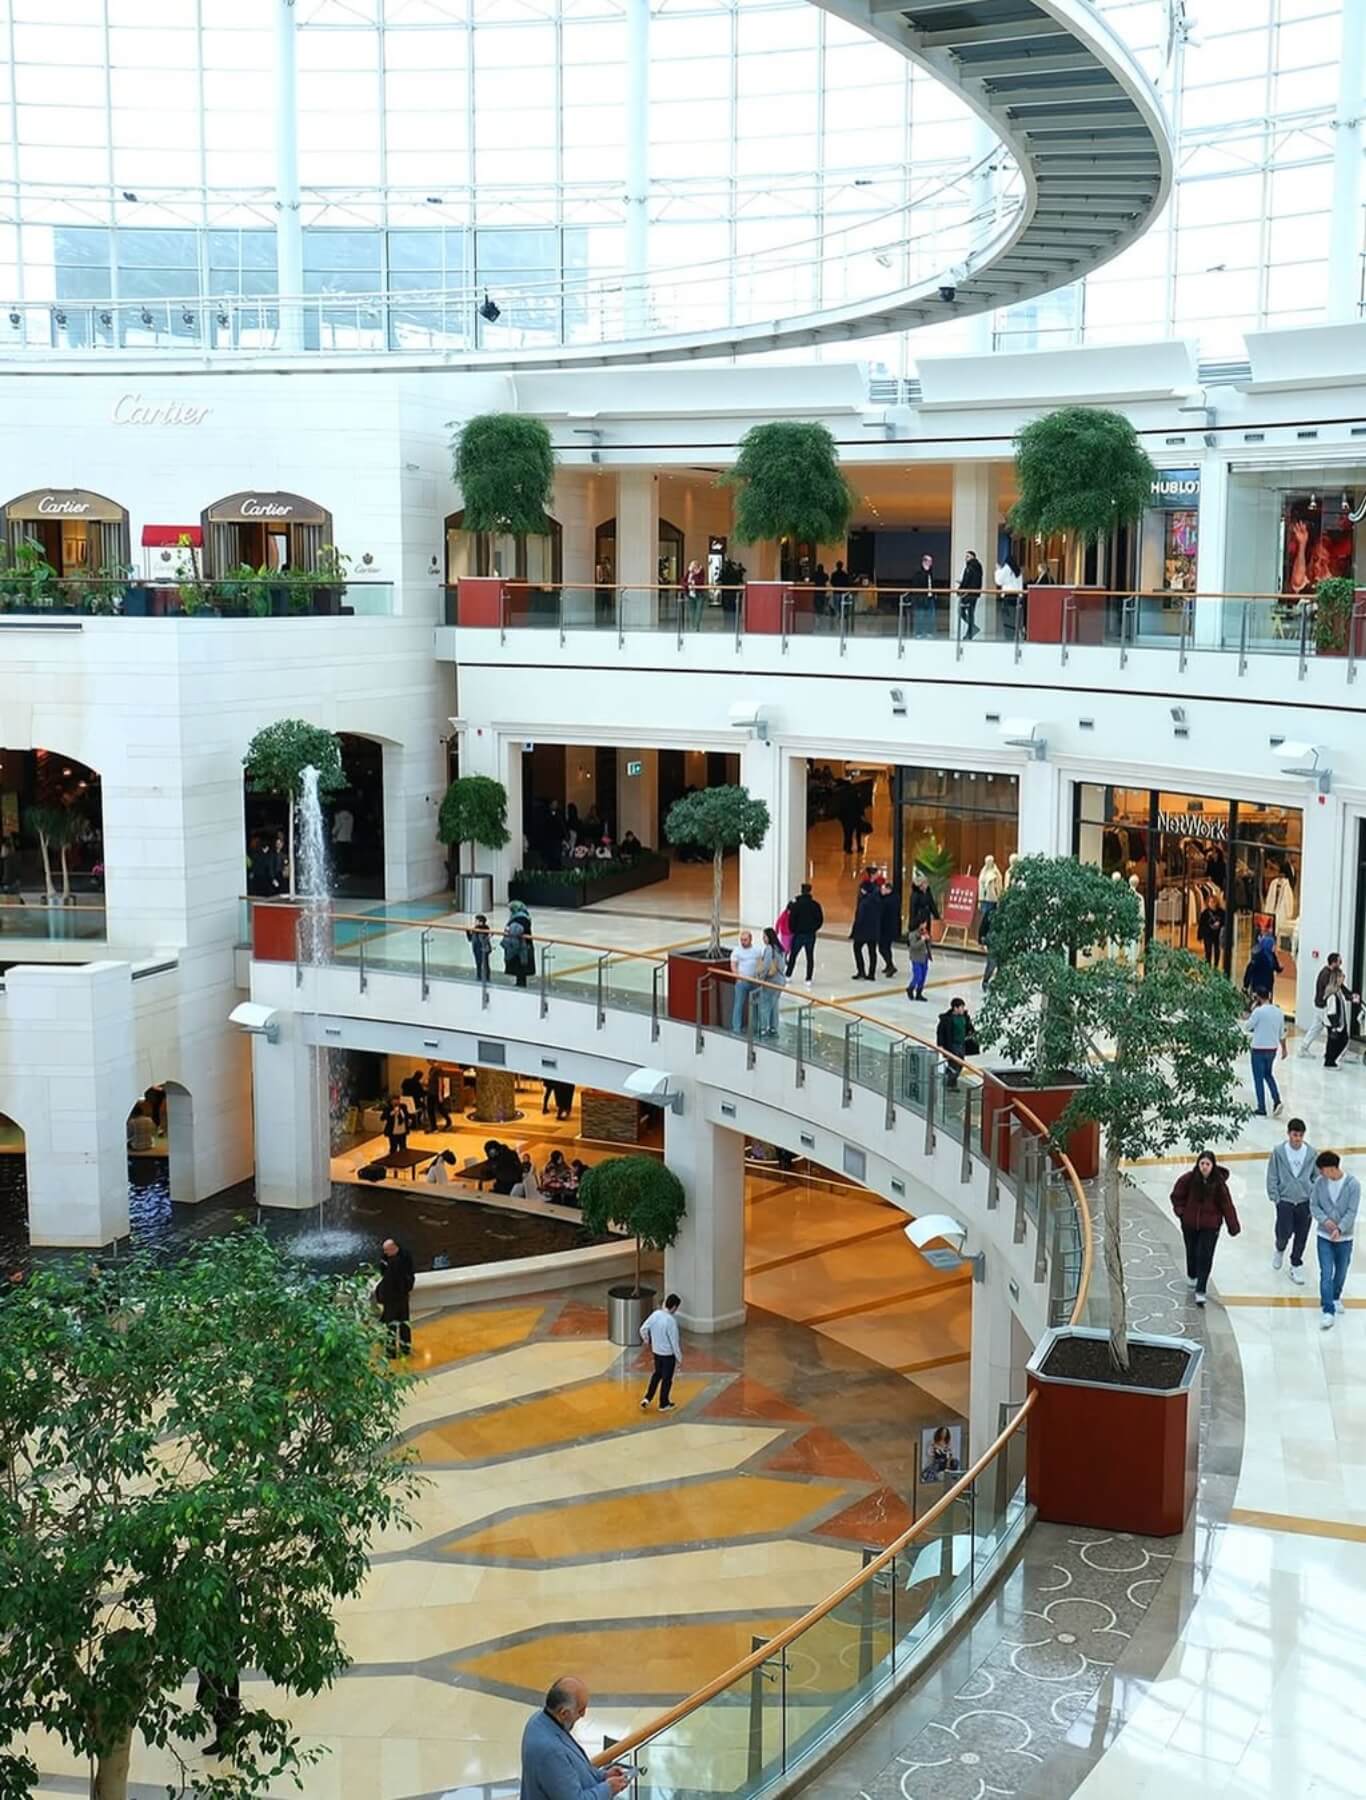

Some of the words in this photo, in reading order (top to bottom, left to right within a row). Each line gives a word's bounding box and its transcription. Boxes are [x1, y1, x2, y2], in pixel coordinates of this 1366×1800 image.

[112, 393, 213, 425] Cartier
[38, 496, 90, 513] Cartier
[241, 498, 293, 516] Cartier
